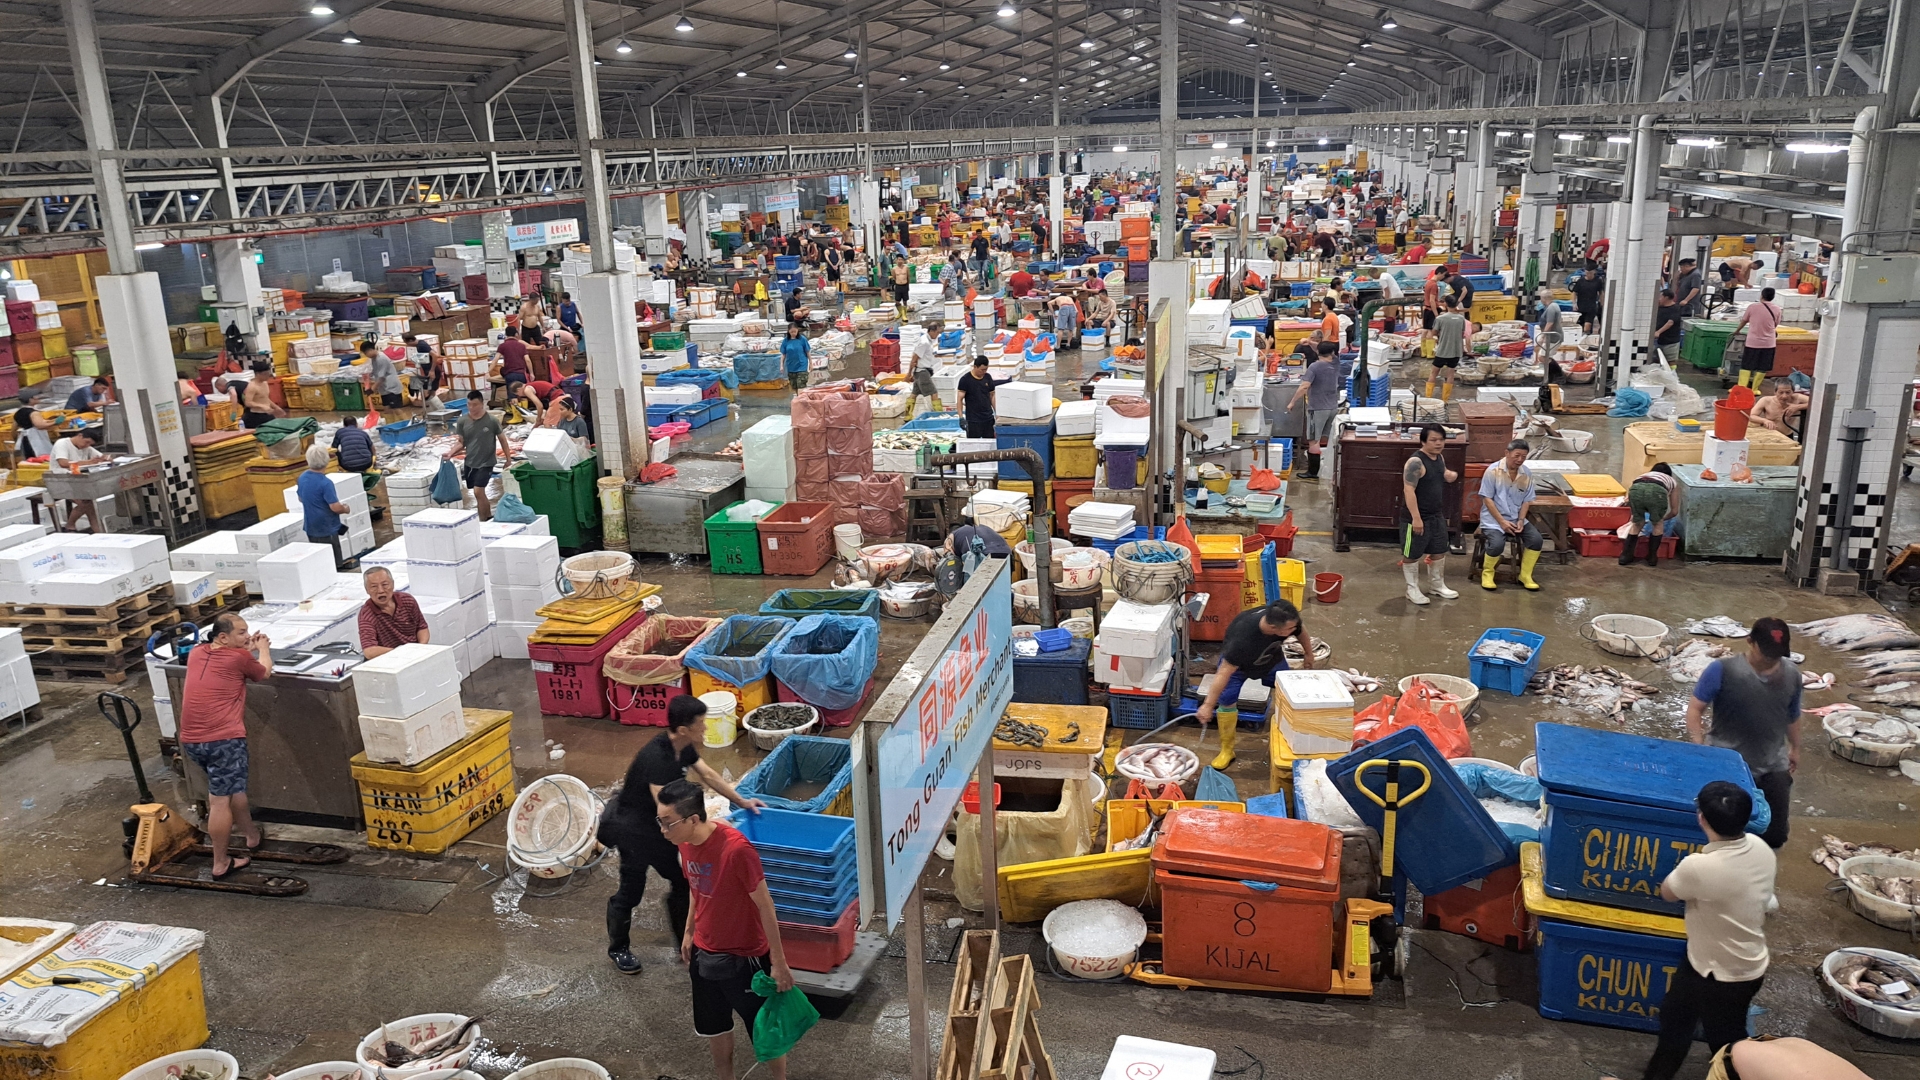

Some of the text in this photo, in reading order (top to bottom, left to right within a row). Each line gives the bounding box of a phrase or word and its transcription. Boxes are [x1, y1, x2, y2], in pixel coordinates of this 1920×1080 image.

[1587, 509, 1612, 518] 8936
[75, 553, 107, 561] seaborn
[736, 553, 753, 565] HS
[551, 689, 581, 701] 1981
[635, 699, 667, 710] 2069
[887, 638, 1011, 866] Tong Guan Fish Merchant
[372, 789, 423, 816] IKAN
[373, 819, 414, 846] 289
[1583, 828, 1660, 876] CHUN
[1234, 902, 1256, 937] 8
[1067, 955, 1119, 972] 7522
[1206, 945, 1280, 973] KIJAL
[1577, 954, 1652, 998] CHUN
